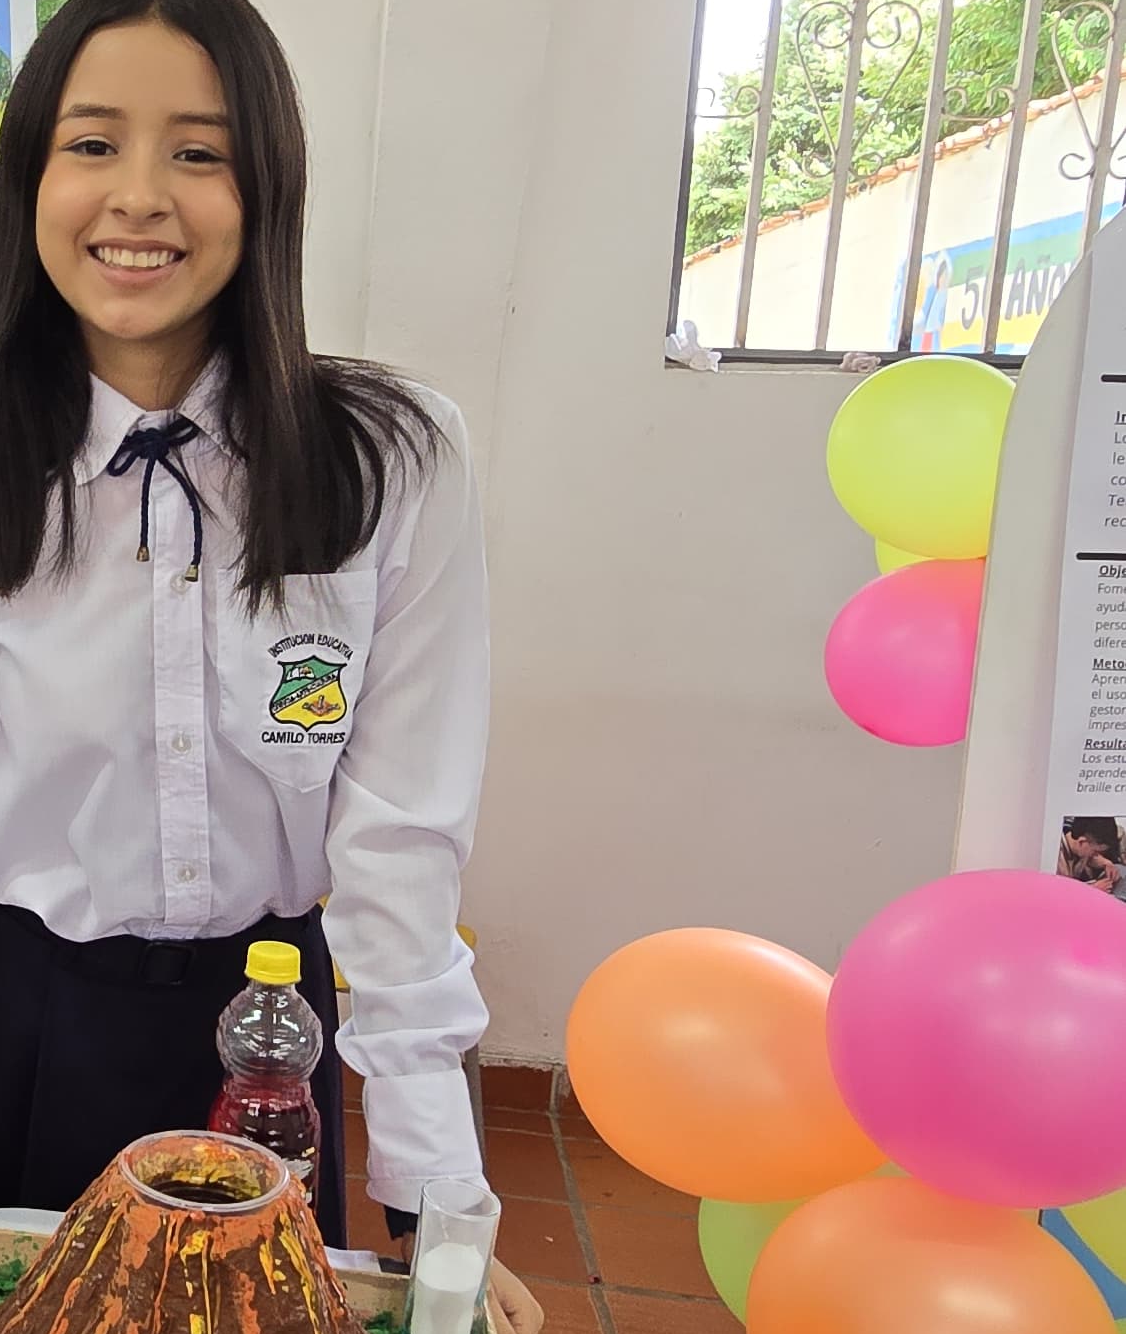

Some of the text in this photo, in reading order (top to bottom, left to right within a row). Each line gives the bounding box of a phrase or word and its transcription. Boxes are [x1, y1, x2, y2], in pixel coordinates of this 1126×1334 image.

[1096, 601, 1126, 615] ayud
[1092, 658, 1126, 670] Meto
[261, 731, 346, 744] CAMILO TORRES
[1082, 753, 1102, 764] Los
[1076, 781, 1112, 793] braille
